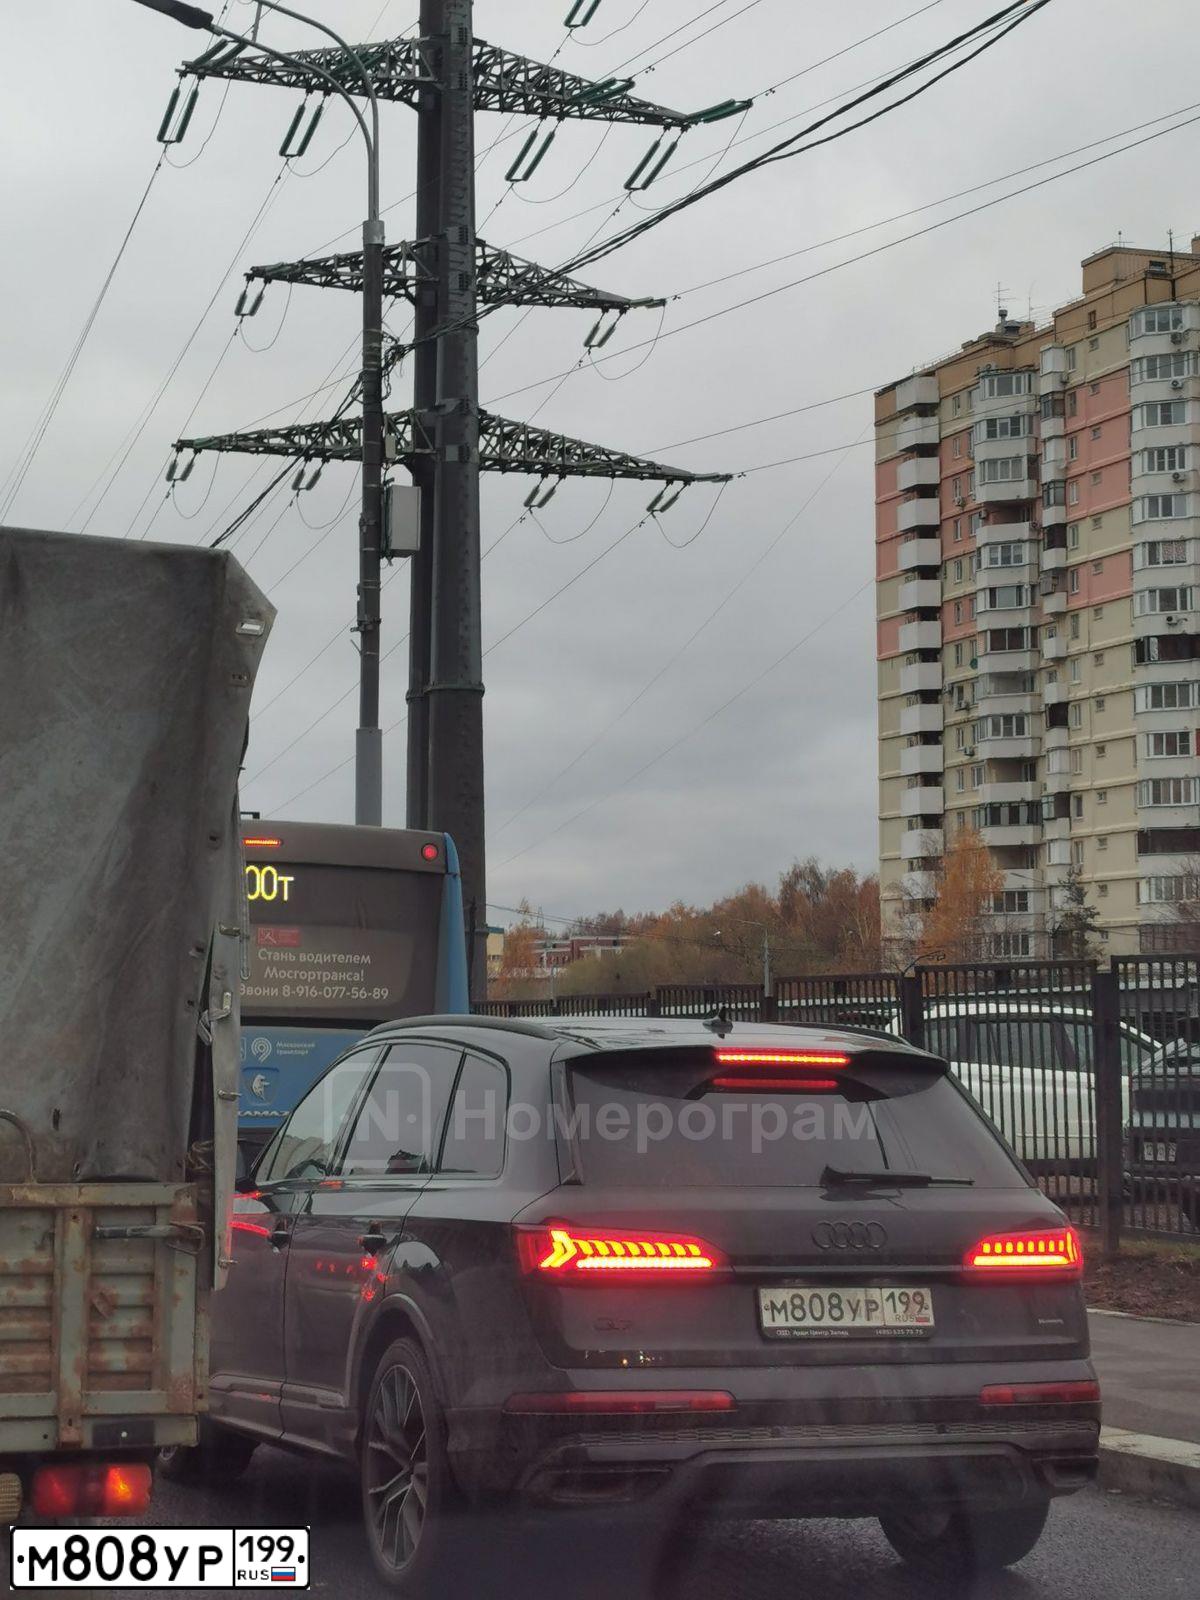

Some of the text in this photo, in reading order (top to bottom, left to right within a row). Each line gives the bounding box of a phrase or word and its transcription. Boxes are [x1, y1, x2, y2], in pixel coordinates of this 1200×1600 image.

[258, 948, 371, 964] Стань водителем
[264, 966, 364, 983] Мосгортранса!
[240, 983, 389, 999] Звони 8-916-077-56-89
[770, 1291, 926, 1323] М808УР 199
